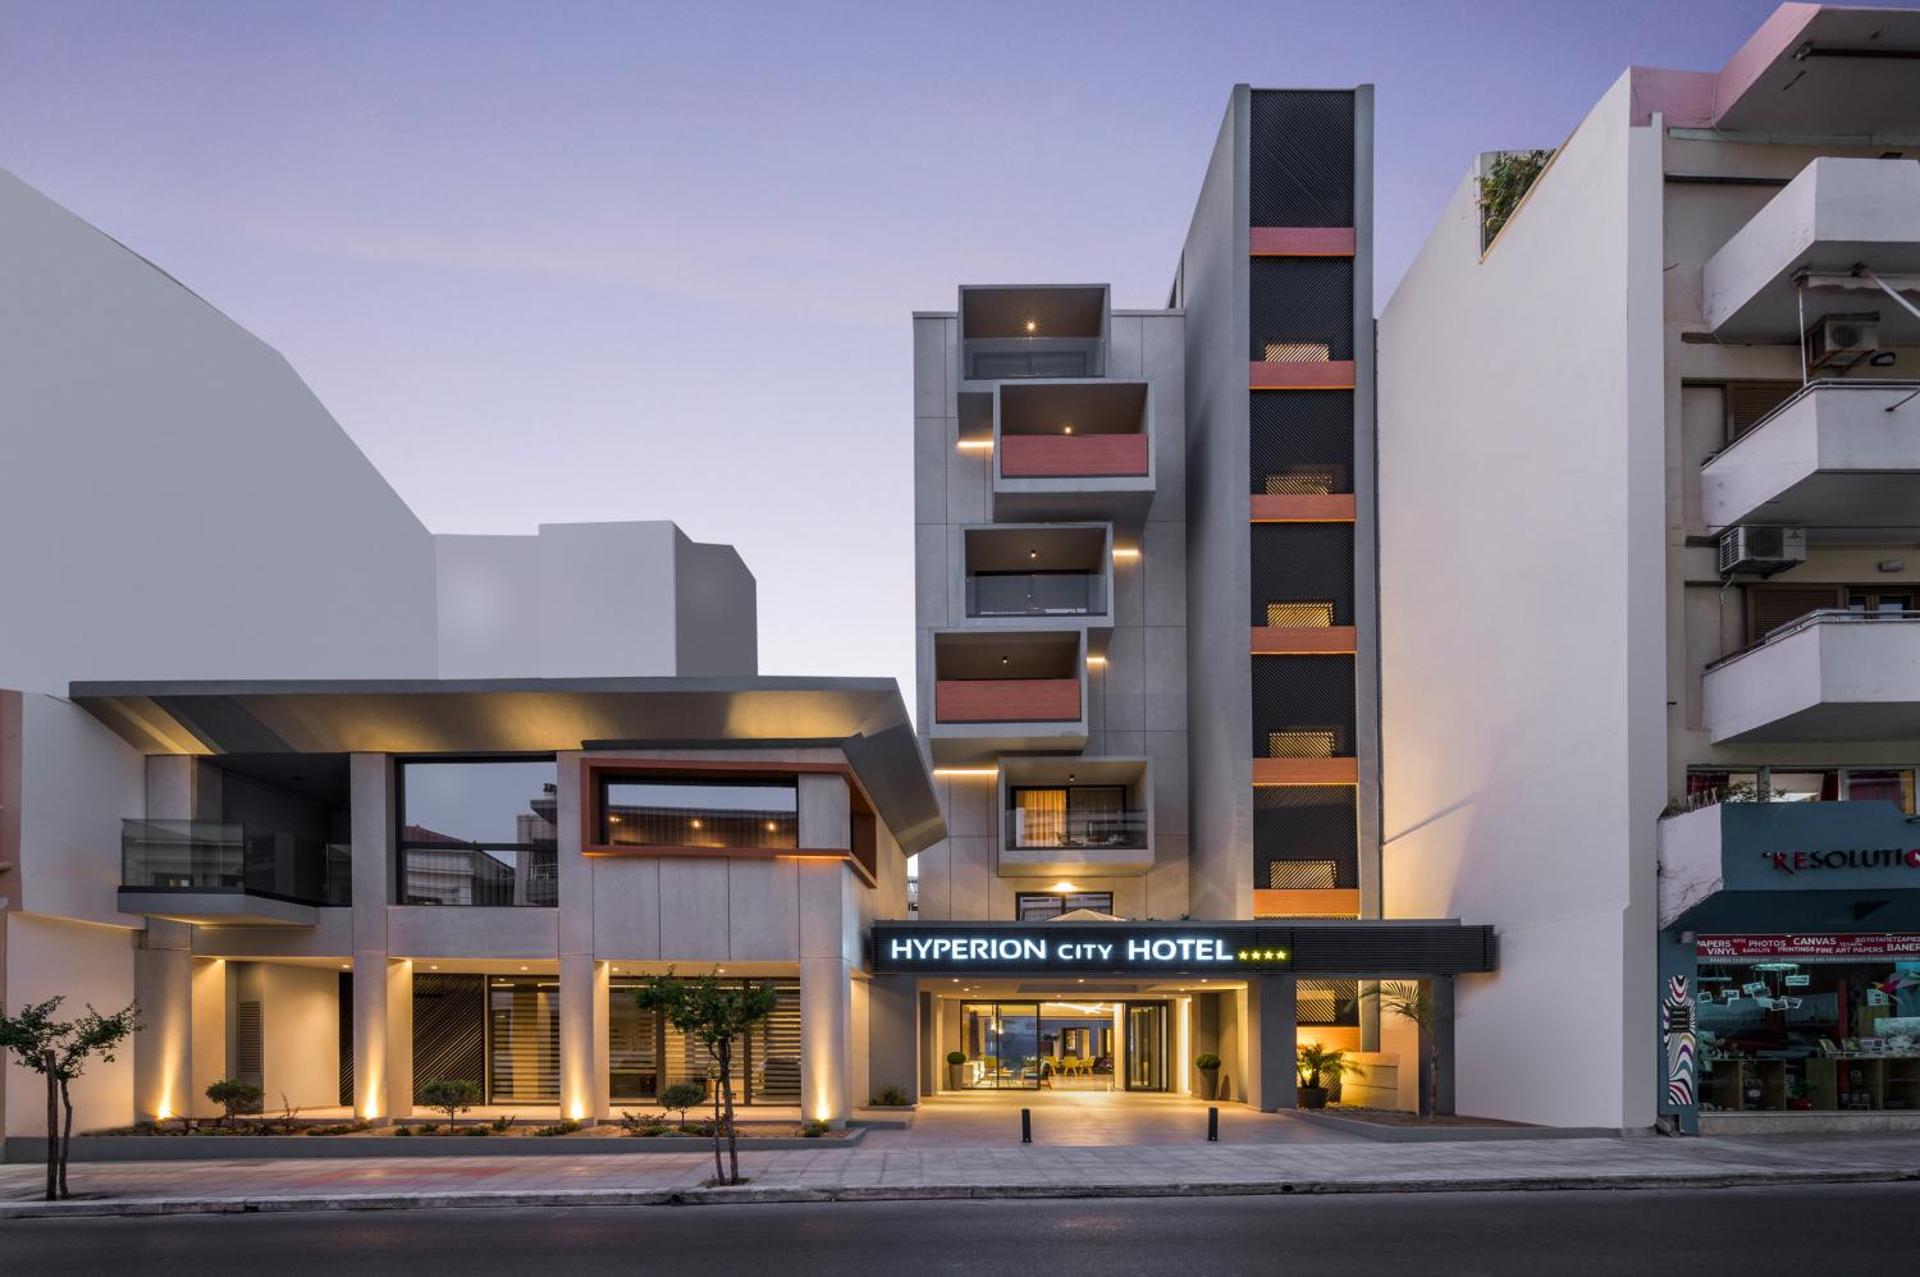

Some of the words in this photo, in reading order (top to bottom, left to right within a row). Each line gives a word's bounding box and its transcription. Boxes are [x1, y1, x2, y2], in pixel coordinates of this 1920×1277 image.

[1748, 939, 1787, 947] PHOTOS
[1793, 937, 1837, 945] CANVAS
[890, 938, 1047, 960] HYPERION
[1057, 943, 1113, 960] CITY
[1128, 938, 1234, 961] HOTEL
[1706, 947, 1738, 955] VINYL
